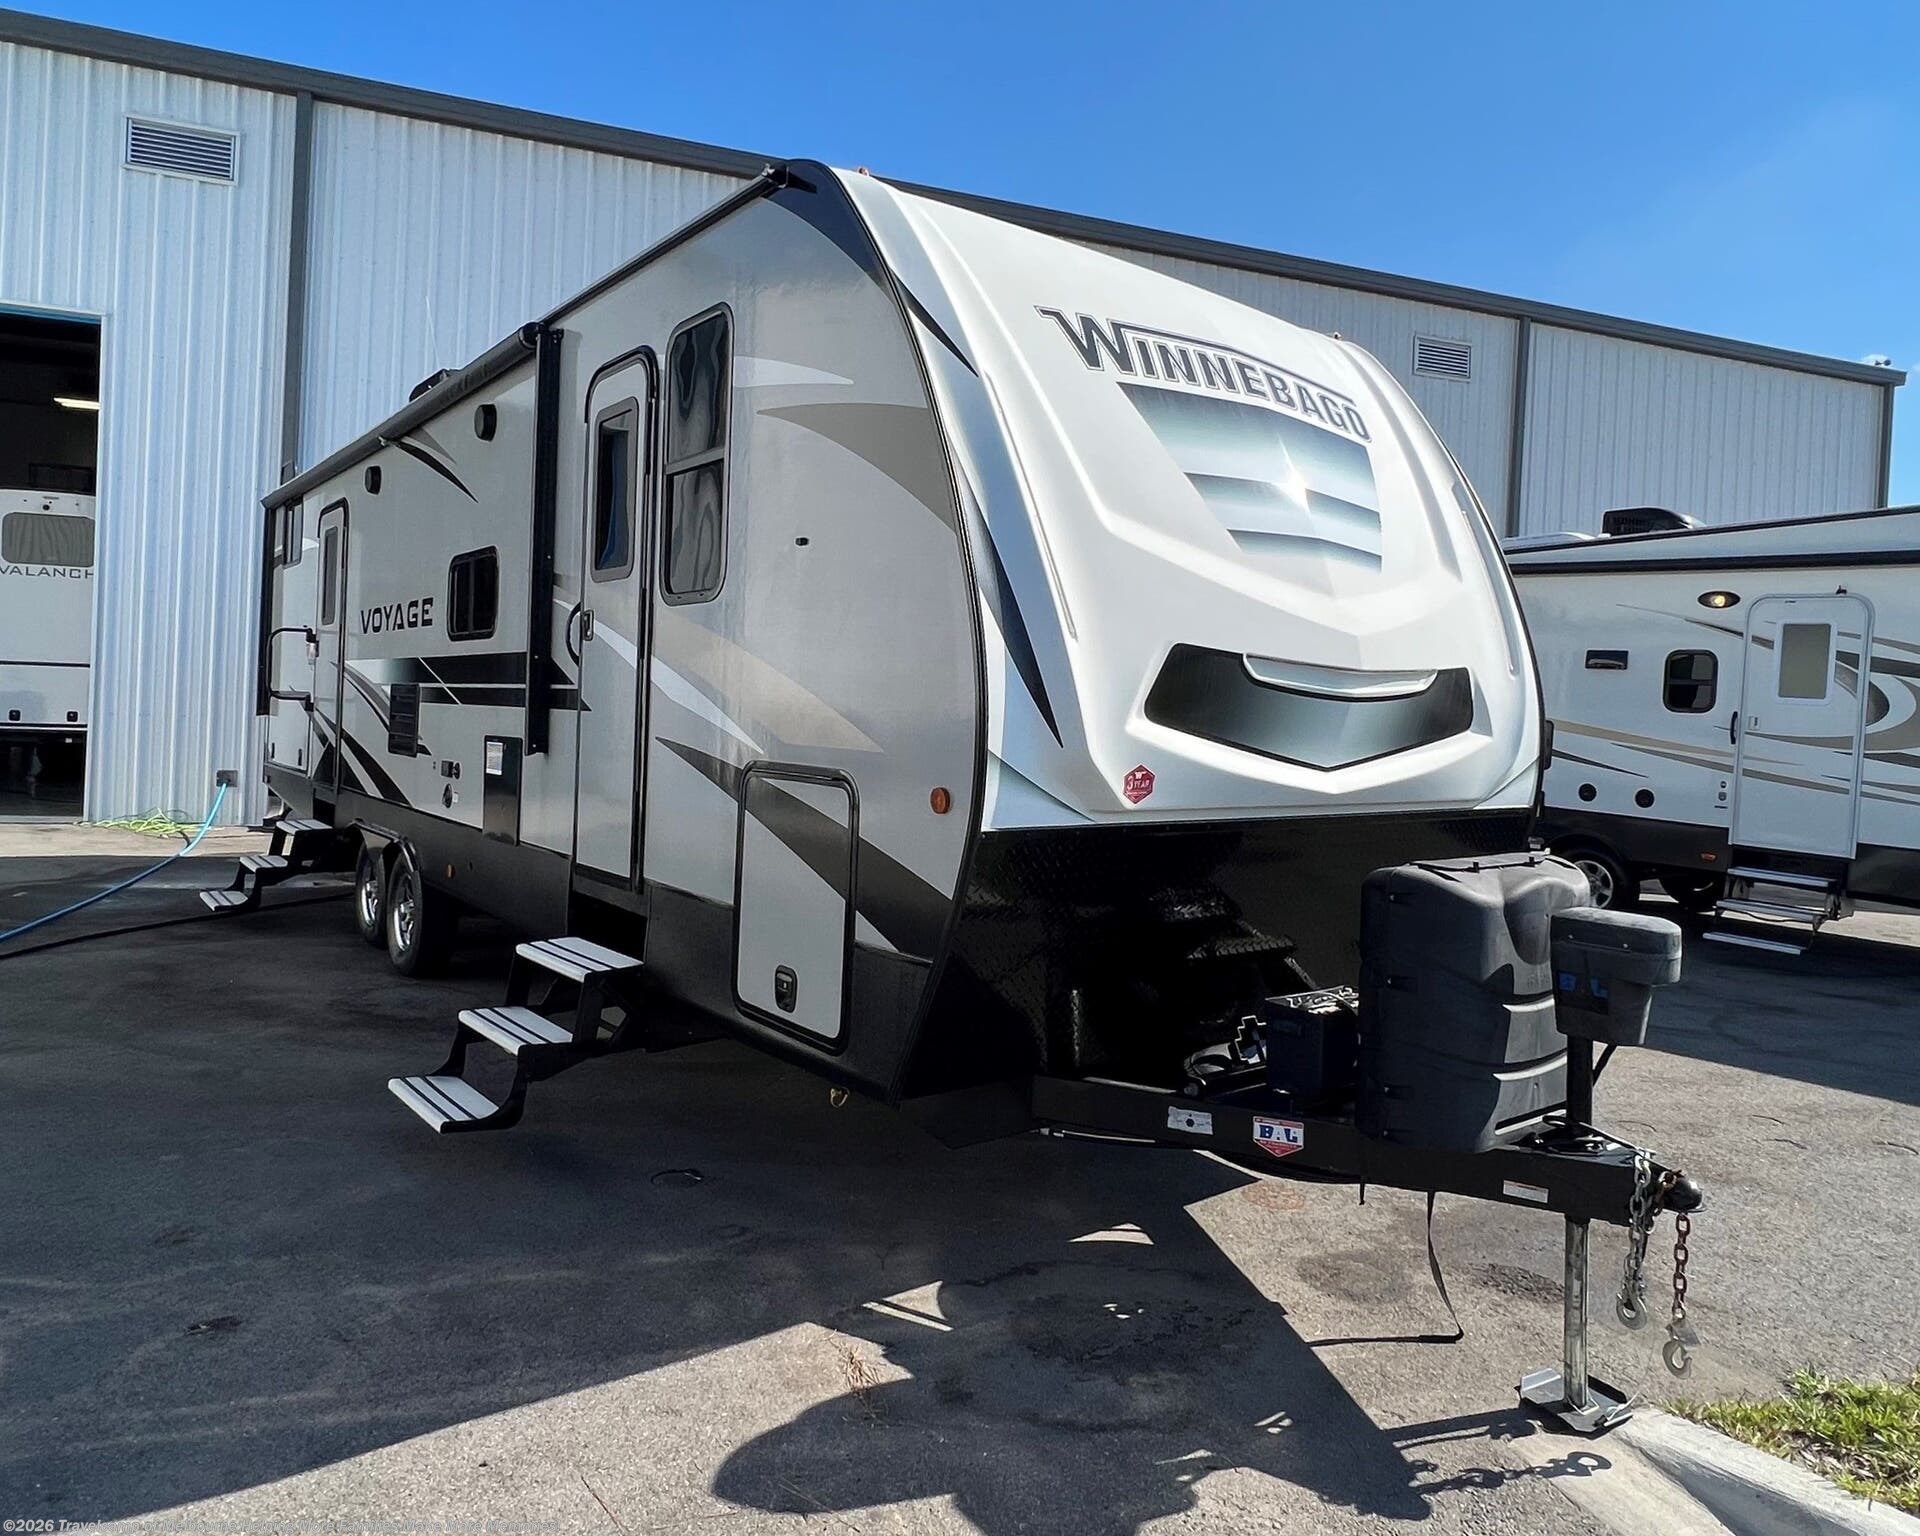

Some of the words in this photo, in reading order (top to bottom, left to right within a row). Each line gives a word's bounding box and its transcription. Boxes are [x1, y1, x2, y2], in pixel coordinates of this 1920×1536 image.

[1034, 305, 1373, 443] WINNEBAGO
[360, 597, 434, 635] VOYAGE
[1259, 1124, 1298, 1143] BAL
